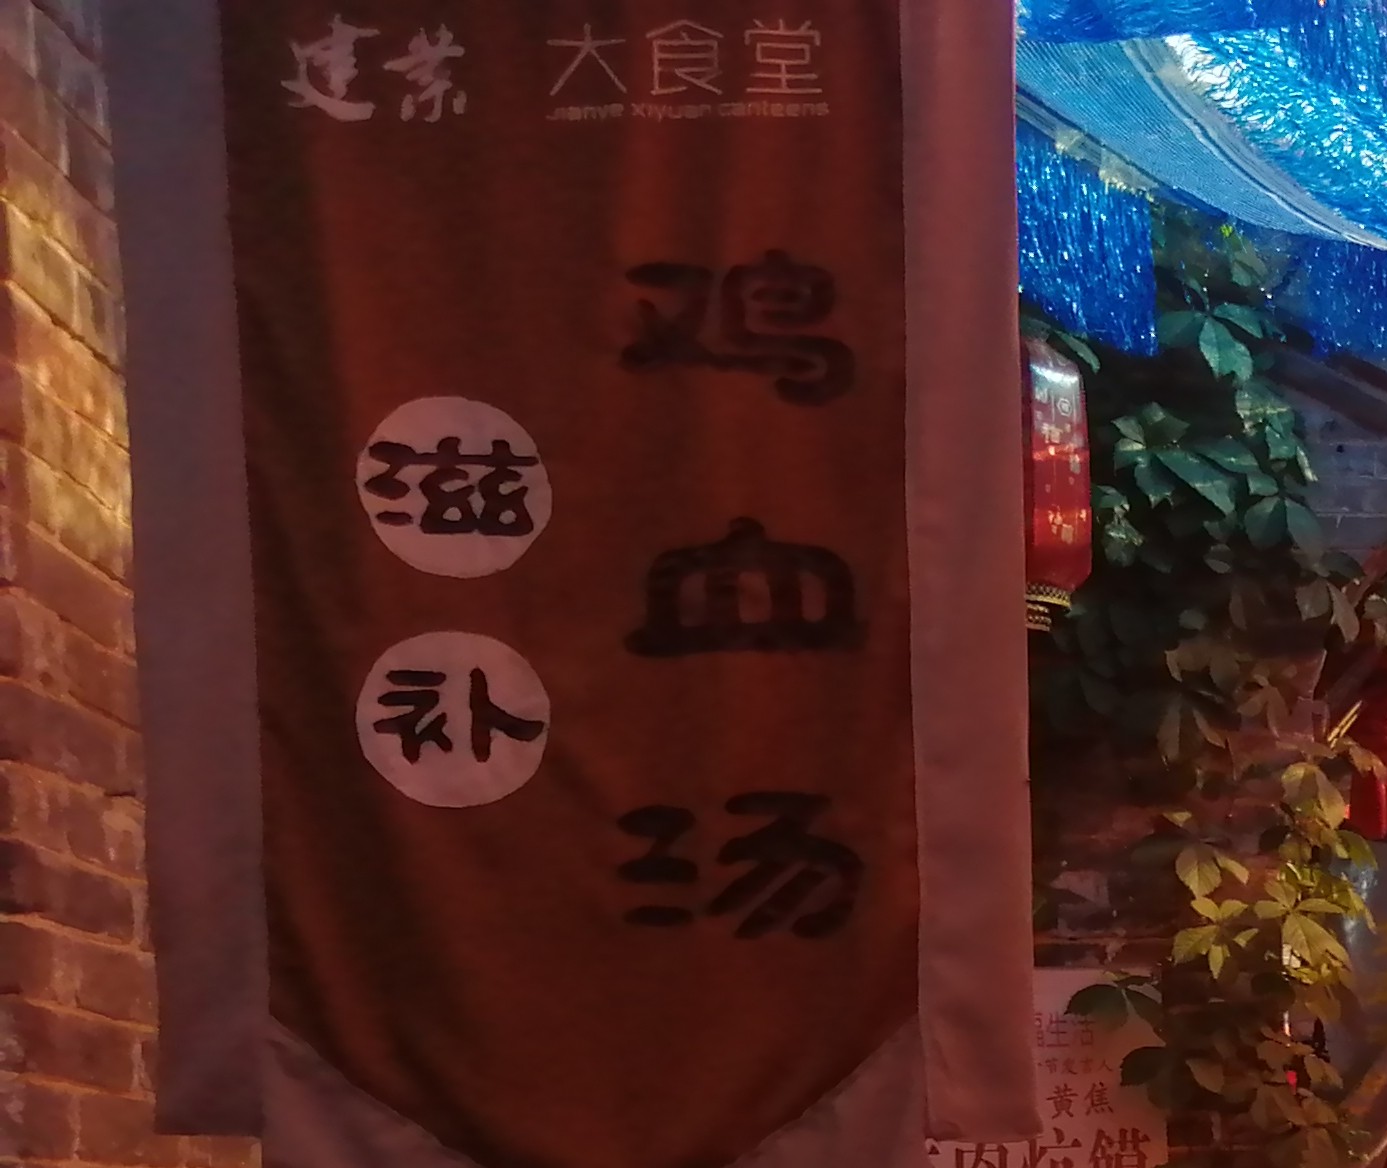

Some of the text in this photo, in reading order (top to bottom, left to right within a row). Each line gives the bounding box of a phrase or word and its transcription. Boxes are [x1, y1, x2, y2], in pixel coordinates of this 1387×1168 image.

[546, 19, 823, 95] 大食堂
[364, 437, 544, 763] 滋补
[618, 248, 870, 939] 鸡血汤
[1047, 1082, 1114, 1119] 黄焦
